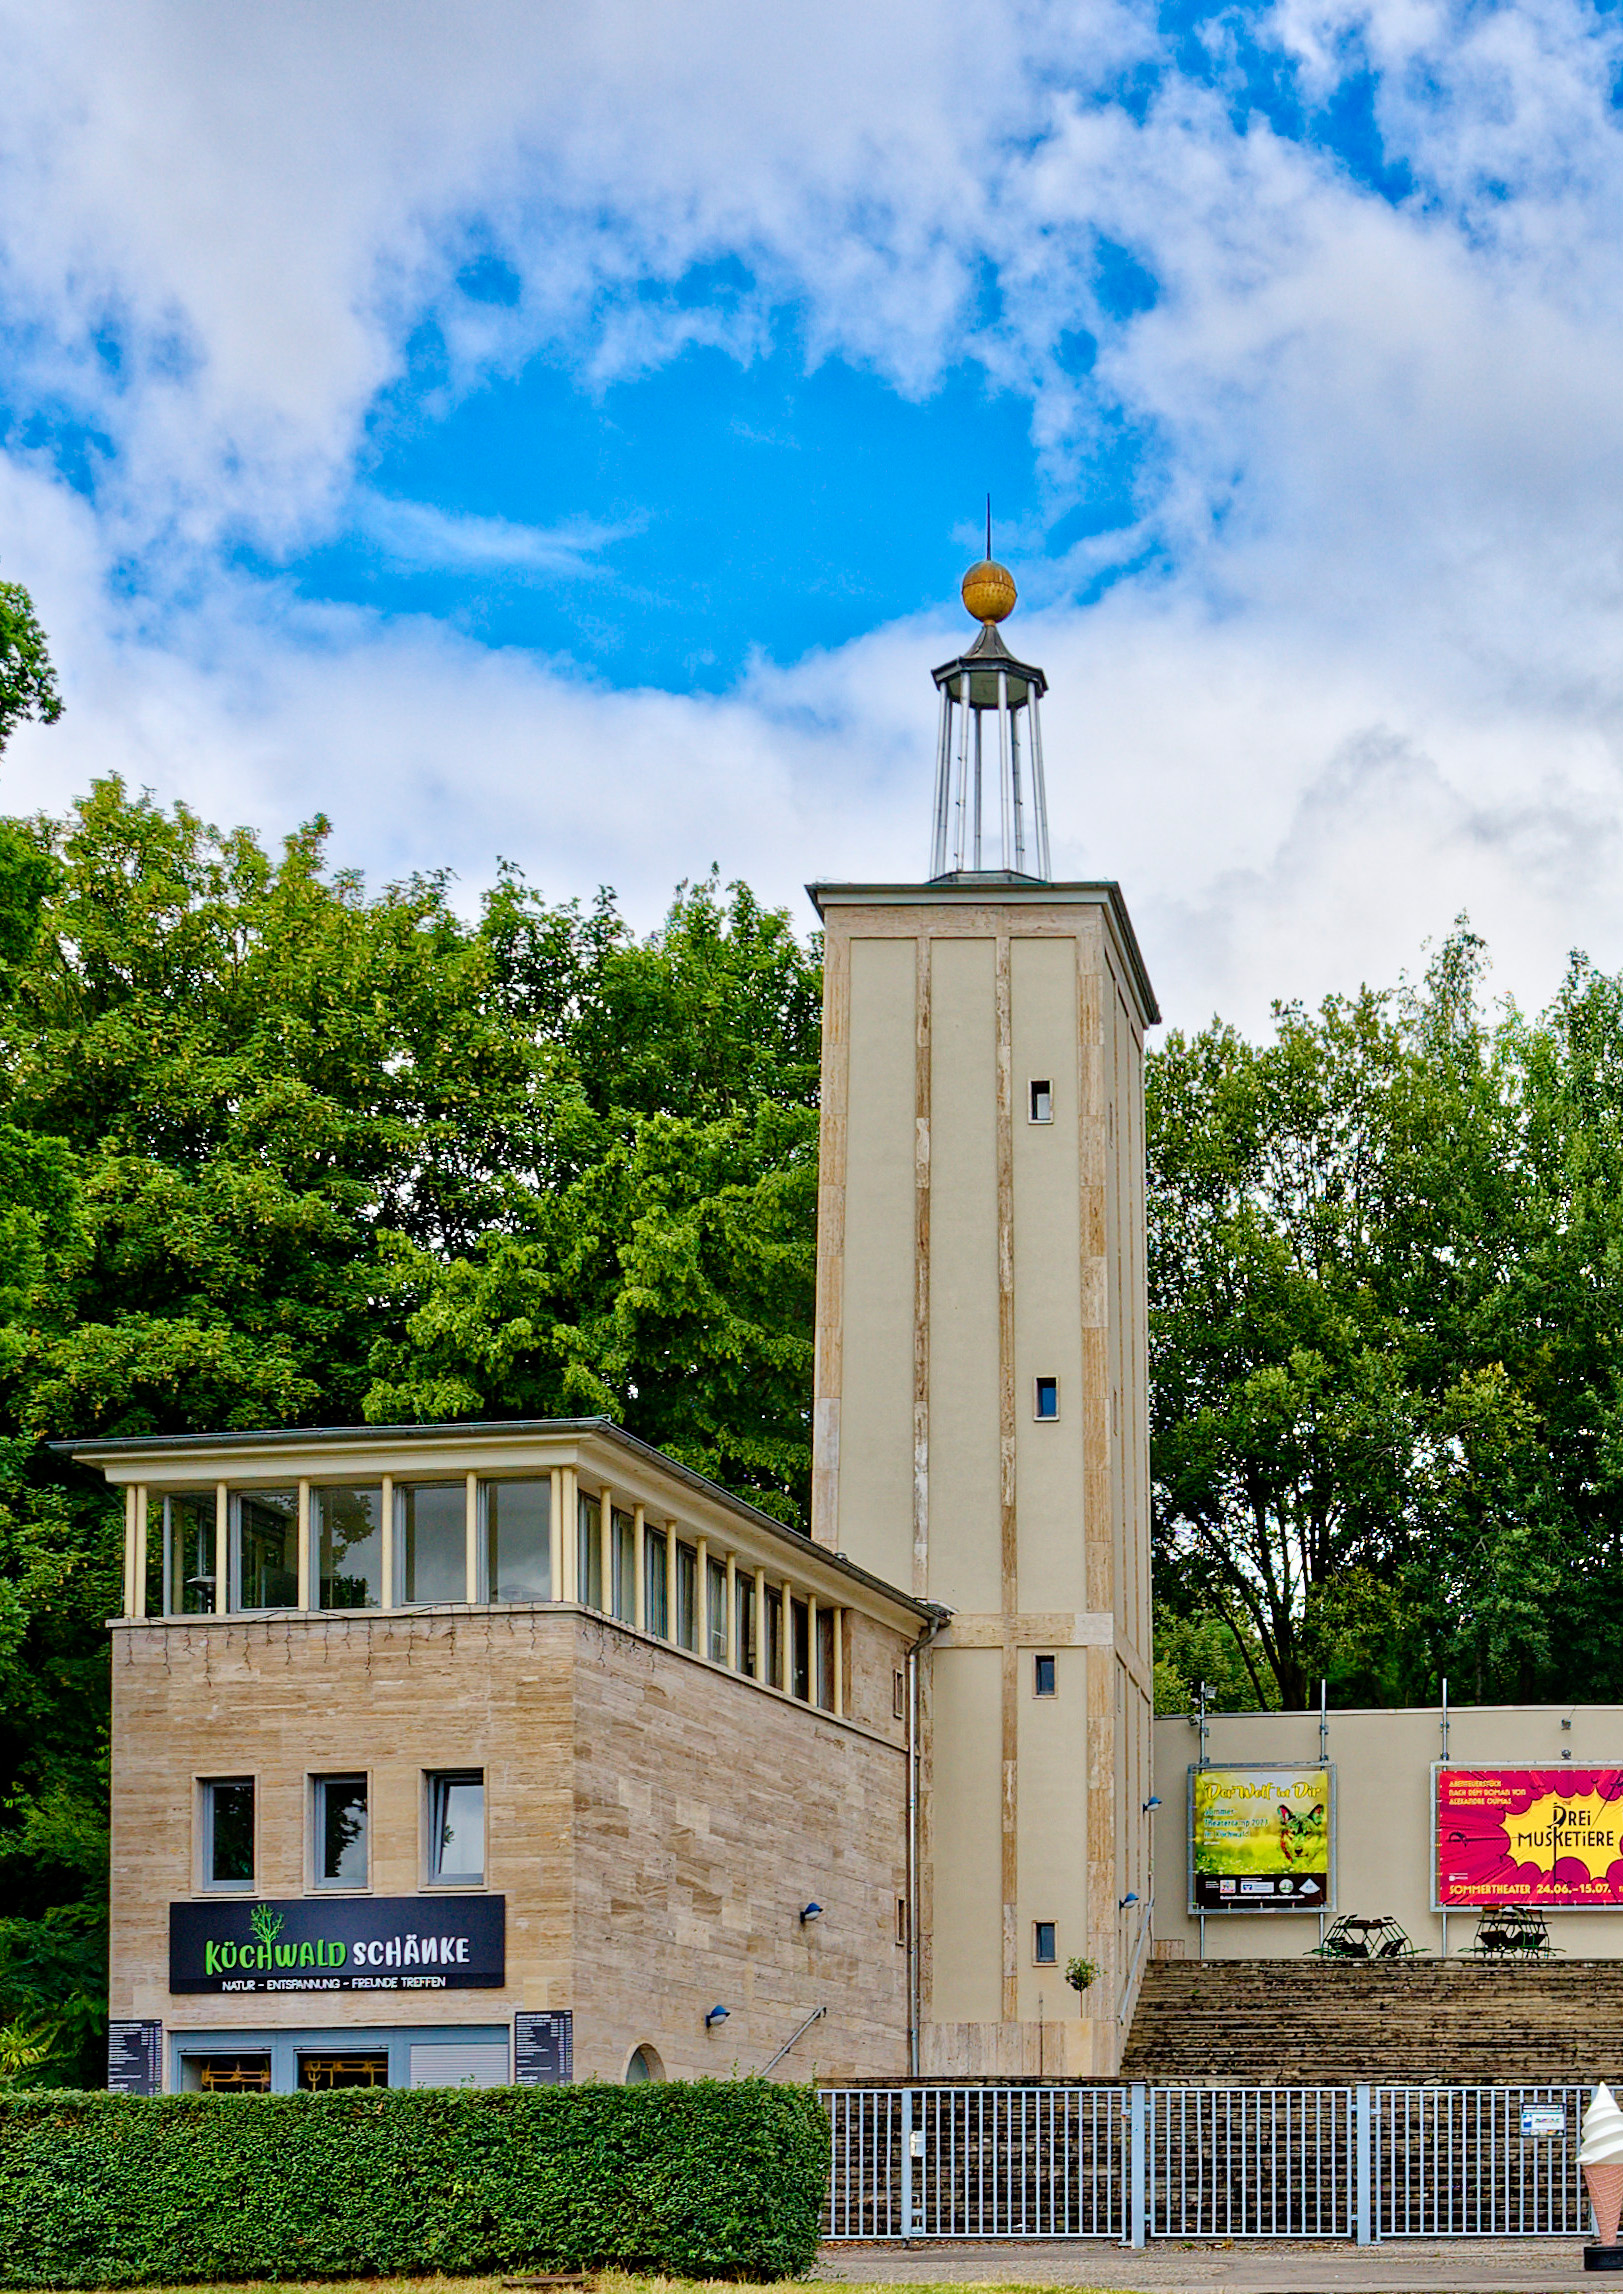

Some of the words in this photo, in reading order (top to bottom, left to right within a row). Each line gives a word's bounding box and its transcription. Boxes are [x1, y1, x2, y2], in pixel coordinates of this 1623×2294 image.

[1205, 1783, 1235, 1800] Der
[1233, 1782, 1275, 1800] Wolf
[1292, 1781, 1321, 1798] Dir
[1449, 1884, 1531, 1894] SOMMERTHEATER
[206, 1939, 346, 1976] KÜCHWALD
[353, 1933, 470, 1968] SCHÄNKE
[222, 1980, 256, 1991] NATUR
[266, 1979, 341, 1990] ENTSPANNUNG
[351, 1977, 398, 1989] FREUNDE
[400, 1976, 446, 1988] TREFFEN
